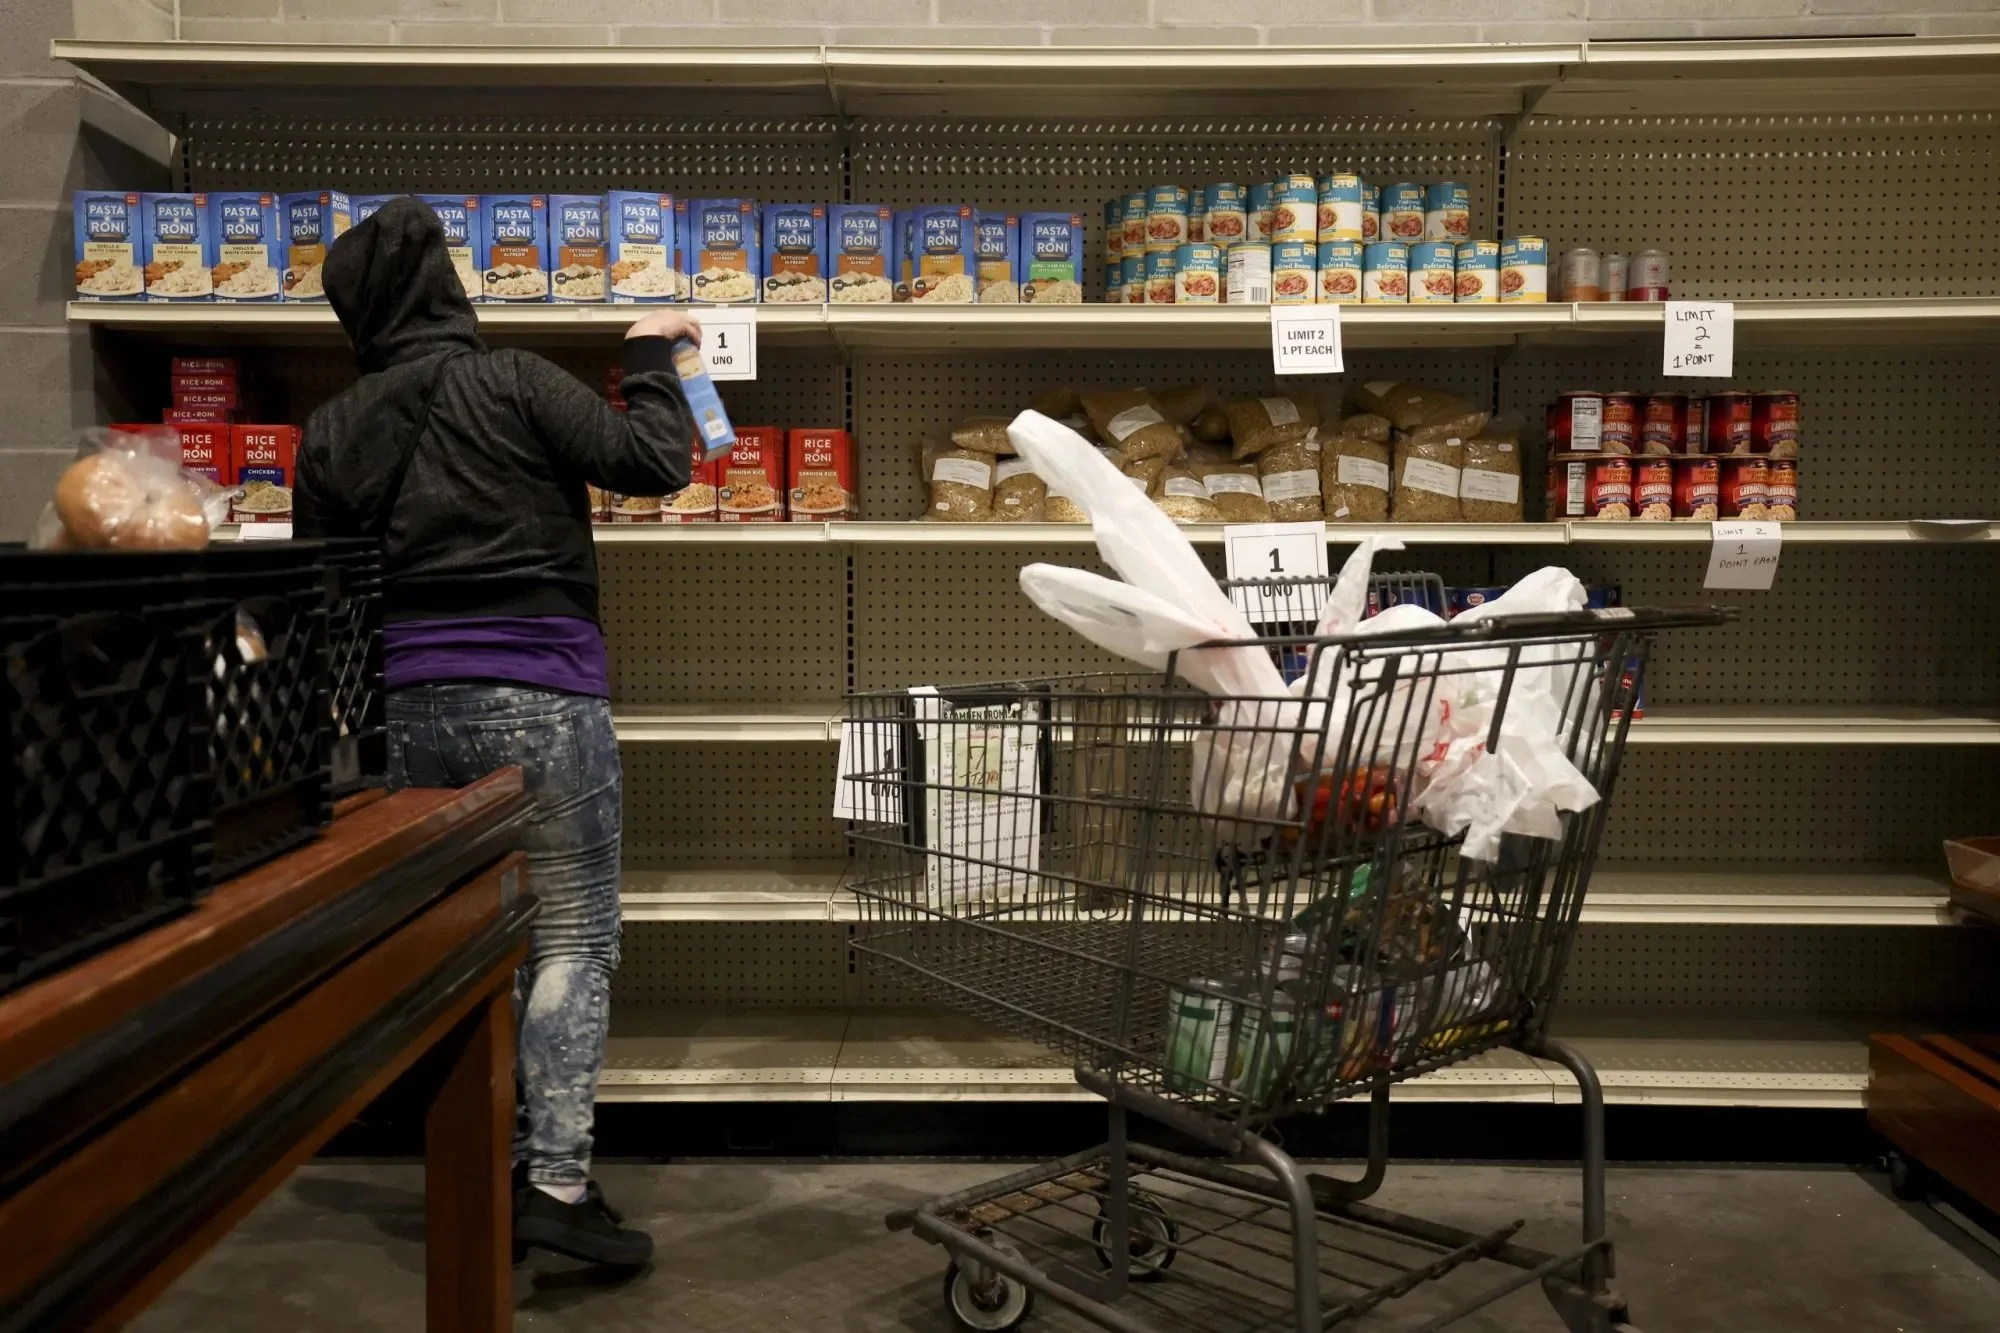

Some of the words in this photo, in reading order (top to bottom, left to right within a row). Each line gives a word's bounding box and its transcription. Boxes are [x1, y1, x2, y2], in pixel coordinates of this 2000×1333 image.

[89, 204, 125, 215] PASTA
[159, 206, 194, 217] PASTA
[224, 207, 259, 217] PASTA
[291, 208, 319, 218] PASTA
[496, 210, 530, 219] PASTA
[625, 206, 658, 217] PASTA
[437, 210, 465, 220] ASTA
[565, 210, 599, 220] PASTA
[706, 214, 739, 224] PASTA
[91, 221, 125, 233] RONI
[160, 223, 194, 234] RONI
[626, 223, 659, 234] RONI
[778, 219, 811, 228] PASTA
[844, 219, 877, 229] PASTA
[926, 219, 958, 229] PASTA
[226, 224, 259, 234] RONI
[293, 224, 319, 236] RONI
[444, 227, 464, 237] ONI
[498, 227, 530, 237] RONI
[567, 227, 599, 238] RONI
[979, 227, 1004, 236] ASTA
[1036, 227, 1069, 236] PASTA
[707, 231, 739, 241] RONI
[779, 235, 810, 245] RONI
[845, 235, 877, 246] RONI
[927, 235, 957, 246] RONI
[981, 243, 1004, 253] ONI
[1037, 243, 1068, 253] RONI
[1676, 309, 1716, 321] LIMIT
[1287, 330, 1316, 340] LIMIT
[1318, 330, 1325, 340] 2
[1694, 326, 1711, 341] 2
[717, 332, 728, 349] 1
[1282, 346, 1288, 355] 1
[1291, 346, 1302, 355] PT
[1305, 345, 1333, 355] EACH
[712, 355, 733, 365] UNO
[1672, 355, 1683, 368] 1
[182, 434, 212, 444] RICE
[246, 435, 276, 445] RICE
[733, 437, 760, 446] RICE
[804, 439, 831, 448] RICE
[183, 449, 212, 459] RONI
[246, 450, 276, 460] RONI
[732, 451, 760, 461] RONI
[804, 453, 832, 462] RONI
[1755, 527, 1768, 535] 2
[1736, 543, 1748, 555] 1
[1269, 547, 1284, 573] 1
[1720, 559, 1749, 568] POINT
[1262, 584, 1293, 597] UNO
[932, 808, 937, 816] 2
[930, 864, 936, 872] 4
[930, 883, 935, 891] 5
